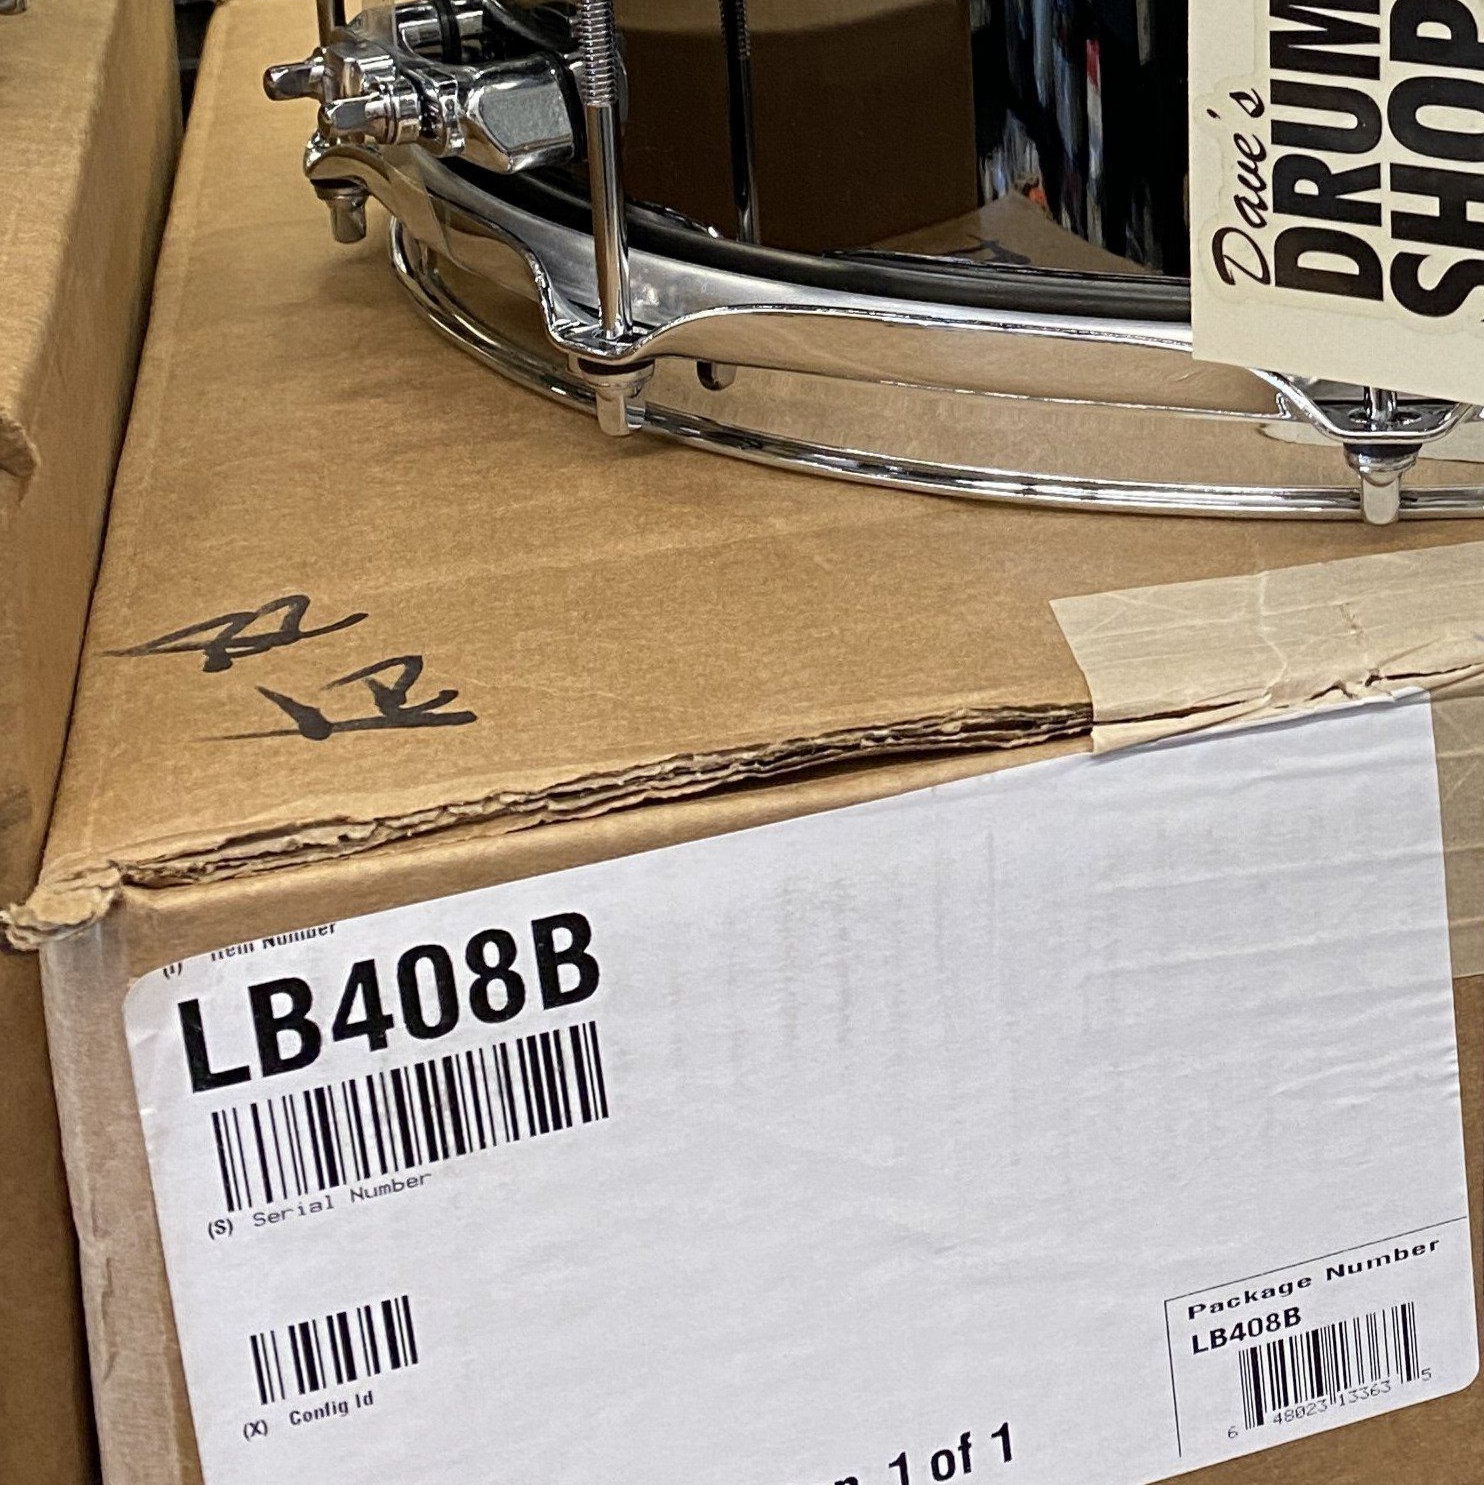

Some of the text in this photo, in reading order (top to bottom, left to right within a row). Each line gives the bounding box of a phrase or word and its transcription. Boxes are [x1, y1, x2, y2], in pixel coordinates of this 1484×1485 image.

[1207, 87, 1271, 286] Dave's
[178, 912, 600, 1093] LB408B
[208, 1173, 432, 1240] (S) Serial Number
[1188, 1239, 1440, 1320] Package Number
[1192, 1306, 1301, 1355] LB408B
[243, 1390, 374, 1441] (X) Config Id
[1227, 1426, 1238, 1439] 6
[1421, 1367, 1432, 1382] 5
[889, 1421, 1012, 1485] 1 of 1
